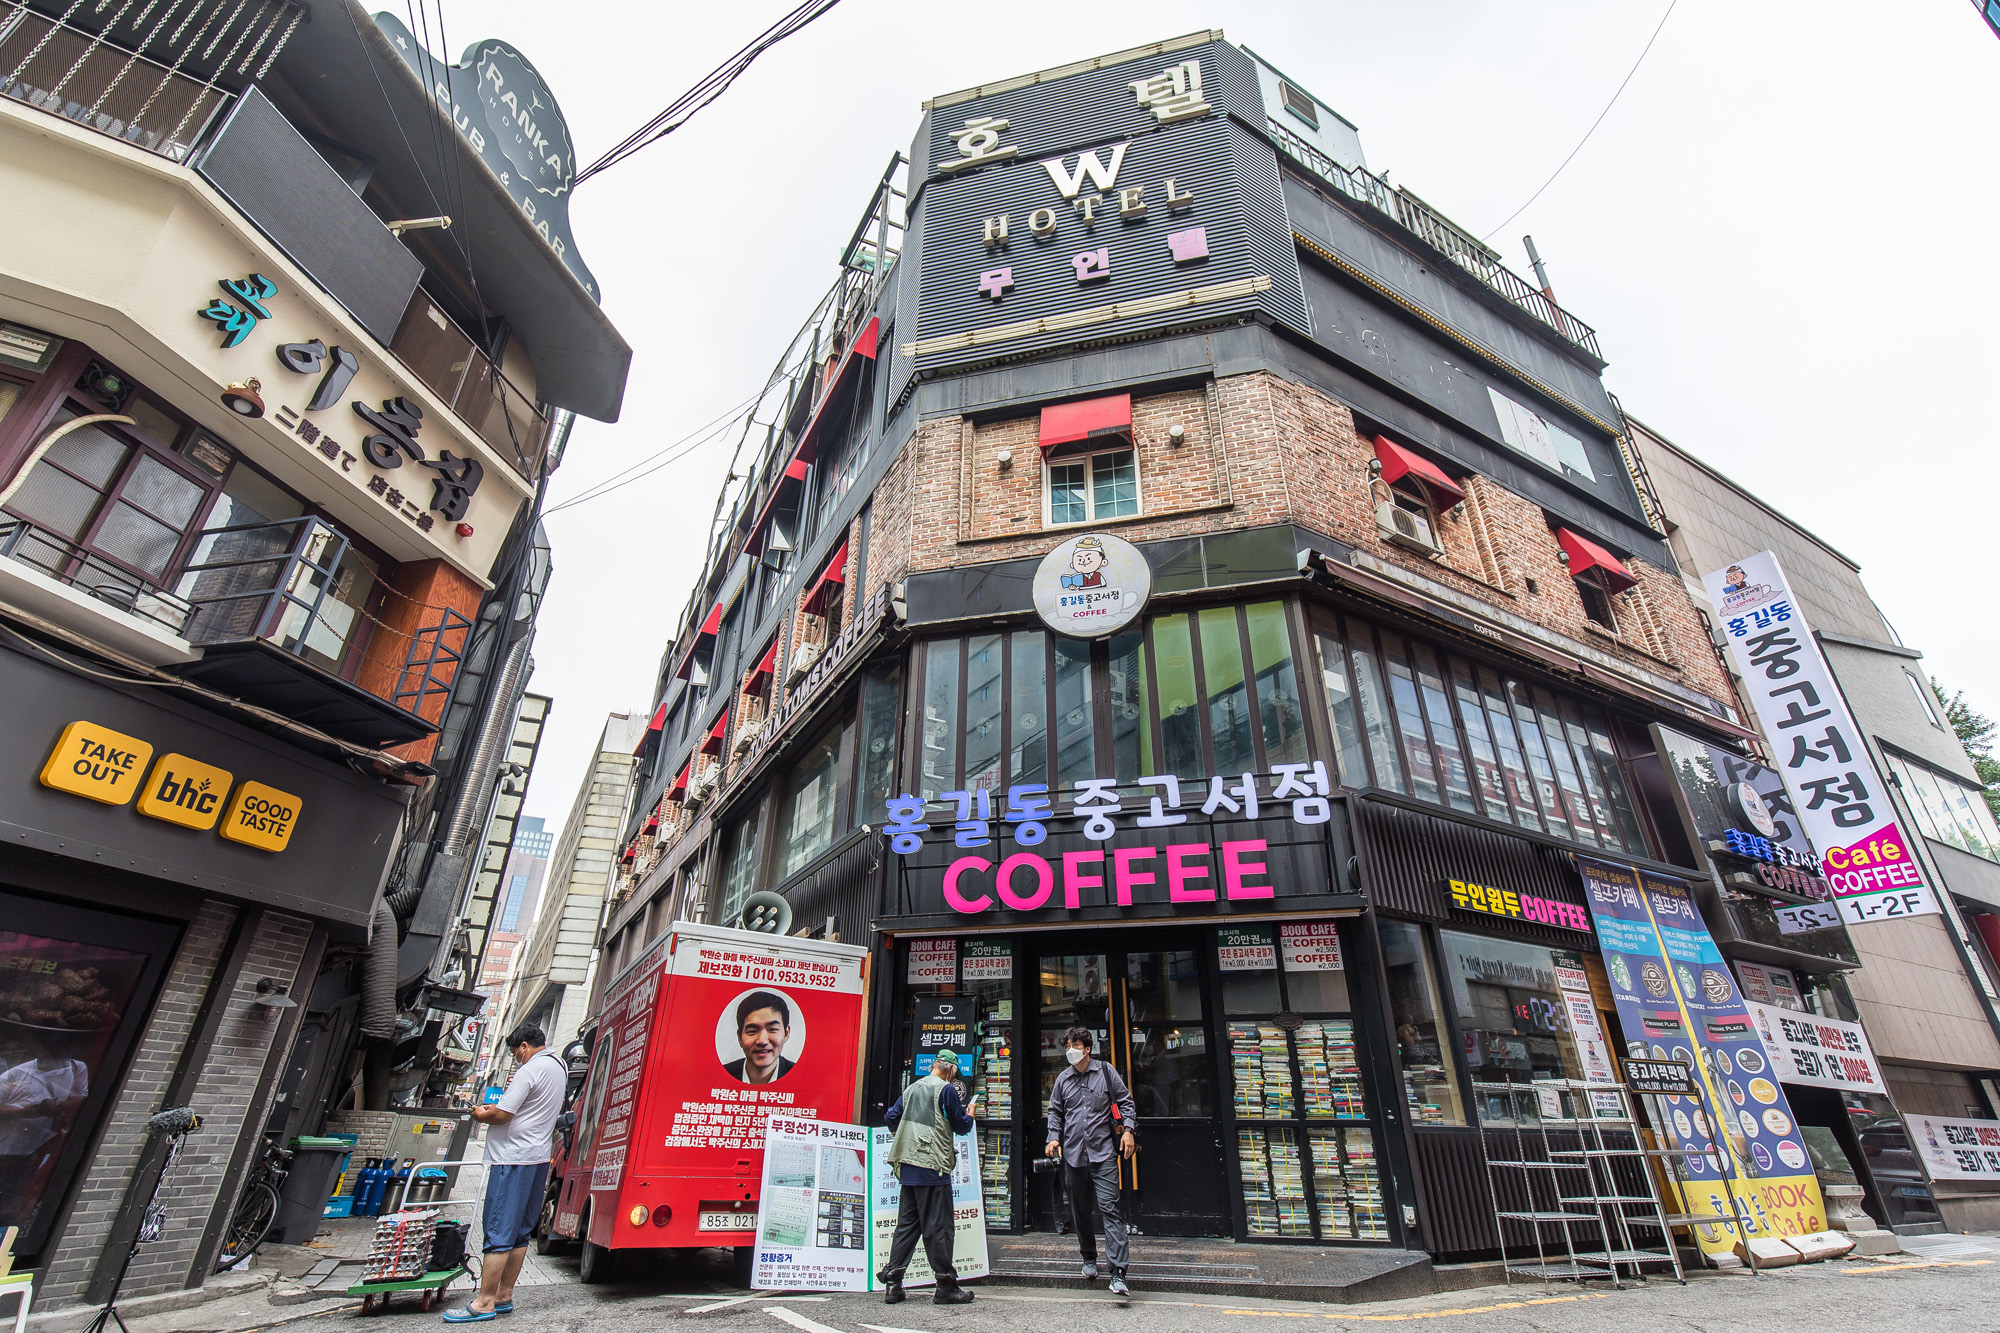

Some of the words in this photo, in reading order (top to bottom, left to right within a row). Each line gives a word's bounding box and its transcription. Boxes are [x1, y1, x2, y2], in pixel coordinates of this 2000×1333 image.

[485, 60, 566, 181] RANKA
[488, 96, 550, 177] HOUSE
[435, 81, 486, 154] PUB
[499, 171, 511, 187] &
[520, 196, 566, 259] BAR
[1039, 142, 1132, 199] W
[981, 177, 1194, 247] HOTEL
[1073, 608, 1107, 618] COFFEE
[1727, 600, 1792, 637] 홍길동
[1474, 624, 1503, 640] COFFEE
[784, 663, 822, 720] TOMS
[821, 582, 889, 679] COFFEE
[1745, 626, 1875, 828] 중고서점
[80, 737, 137, 770] TAKE
[72, 759, 125, 786] OUT
[155, 771, 218, 815] bhc
[243, 795, 293, 822] GOOD
[883, 761, 1331, 855] 홍길동중고서점
[239, 810, 288, 837] TASTE
[1824, 837, 1902, 870] Café
[942, 839, 1275, 914] COFFEE
[1752, 862, 1824, 900] COFFEE
[1829, 861, 1919, 894] COFFEE
[1449, 879, 1521, 918] 무인원두
[1520, 895, 1591, 931] COFFEE
[1590, 878, 1640, 909] 셀프카페
[1651, 892, 1695, 920] 셀프카페
[1227, 935, 1260, 945] 20만권
[1281, 925, 1309, 936] BOOK
[1311, 924, 1337, 935] CAFE
[1292, 938, 1337, 947] COFFEE
[910, 941, 934, 952] BOOK
[935, 940, 957, 951] CAFE
[918, 953, 954, 961] COFFEE
[971, 946, 1000, 956] 20만권
[1220, 949, 1231, 958] 모든
[1233, 948, 1255, 958] 중고서적
[1256, 948, 1273, 957] 균일가
[1295, 954, 1340, 963] COFFEE
[700, 949, 722, 960] 박원순
[775, 958, 796, 969] 소재지
[797, 961, 811, 970] 제보
[812, 962, 841, 974] 받습니다.
[917, 967, 954, 976] COFFEE
[964, 958, 975, 968] 모든
[975, 958, 995, 968] 중고서적
[995, 957, 1011, 967] 균일가
[697, 961, 743, 978] 제보전화
[752, 967, 836, 988] 010.9533.9532
[1750, 977, 1766, 986] COFFEE
[1753, 989, 1769, 997] COFFEE
[920, 1032, 966, 1047] 셀프카페
[1779, 1017, 1819, 1046] 중고서점
[1816, 1025, 1845, 1052] 30만권
[1843, 1029, 1863, 1054] 보유
[1627, 1062, 1689, 1081] 중고서적판매
[1791, 1048, 1826, 1078] 균일가
[1824, 1053, 1842, 1081] 1권
[1839, 1055, 1874, 1084] 3000원
[681, 1101, 723, 1114] 박원순아들
[724, 1104, 756, 1116] 박주신은
[710, 1088, 738, 1102] 박원순
[739, 1090, 759, 1103] 아들
[759, 1091, 795, 1104] 박주신씨
[673, 1112, 708, 1124] 법정증인
[708, 1115, 733, 1126] 채택이
[771, 1119, 819, 1137] 부정선거
[821, 1127, 838, 1138] 증거
[840, 1130, 867, 1142] 나왔다.
[664, 1135, 707, 1148] 검찰에서도
[708, 1137, 741, 1149] 박주신의
[722, 1126, 748, 1138] 받고도
[1943, 1125, 1979, 1146] 중고서점
[1953, 1150, 1986, 1172] 균일가
[1760, 1184, 1815, 1209] BOOK
[707, 1215, 729, 1227] 85조
[734, 1215, 758, 1227] 021
[1772, 1211, 1819, 1236] Cafe
[760, 1253, 793, 1263] 정황증거
